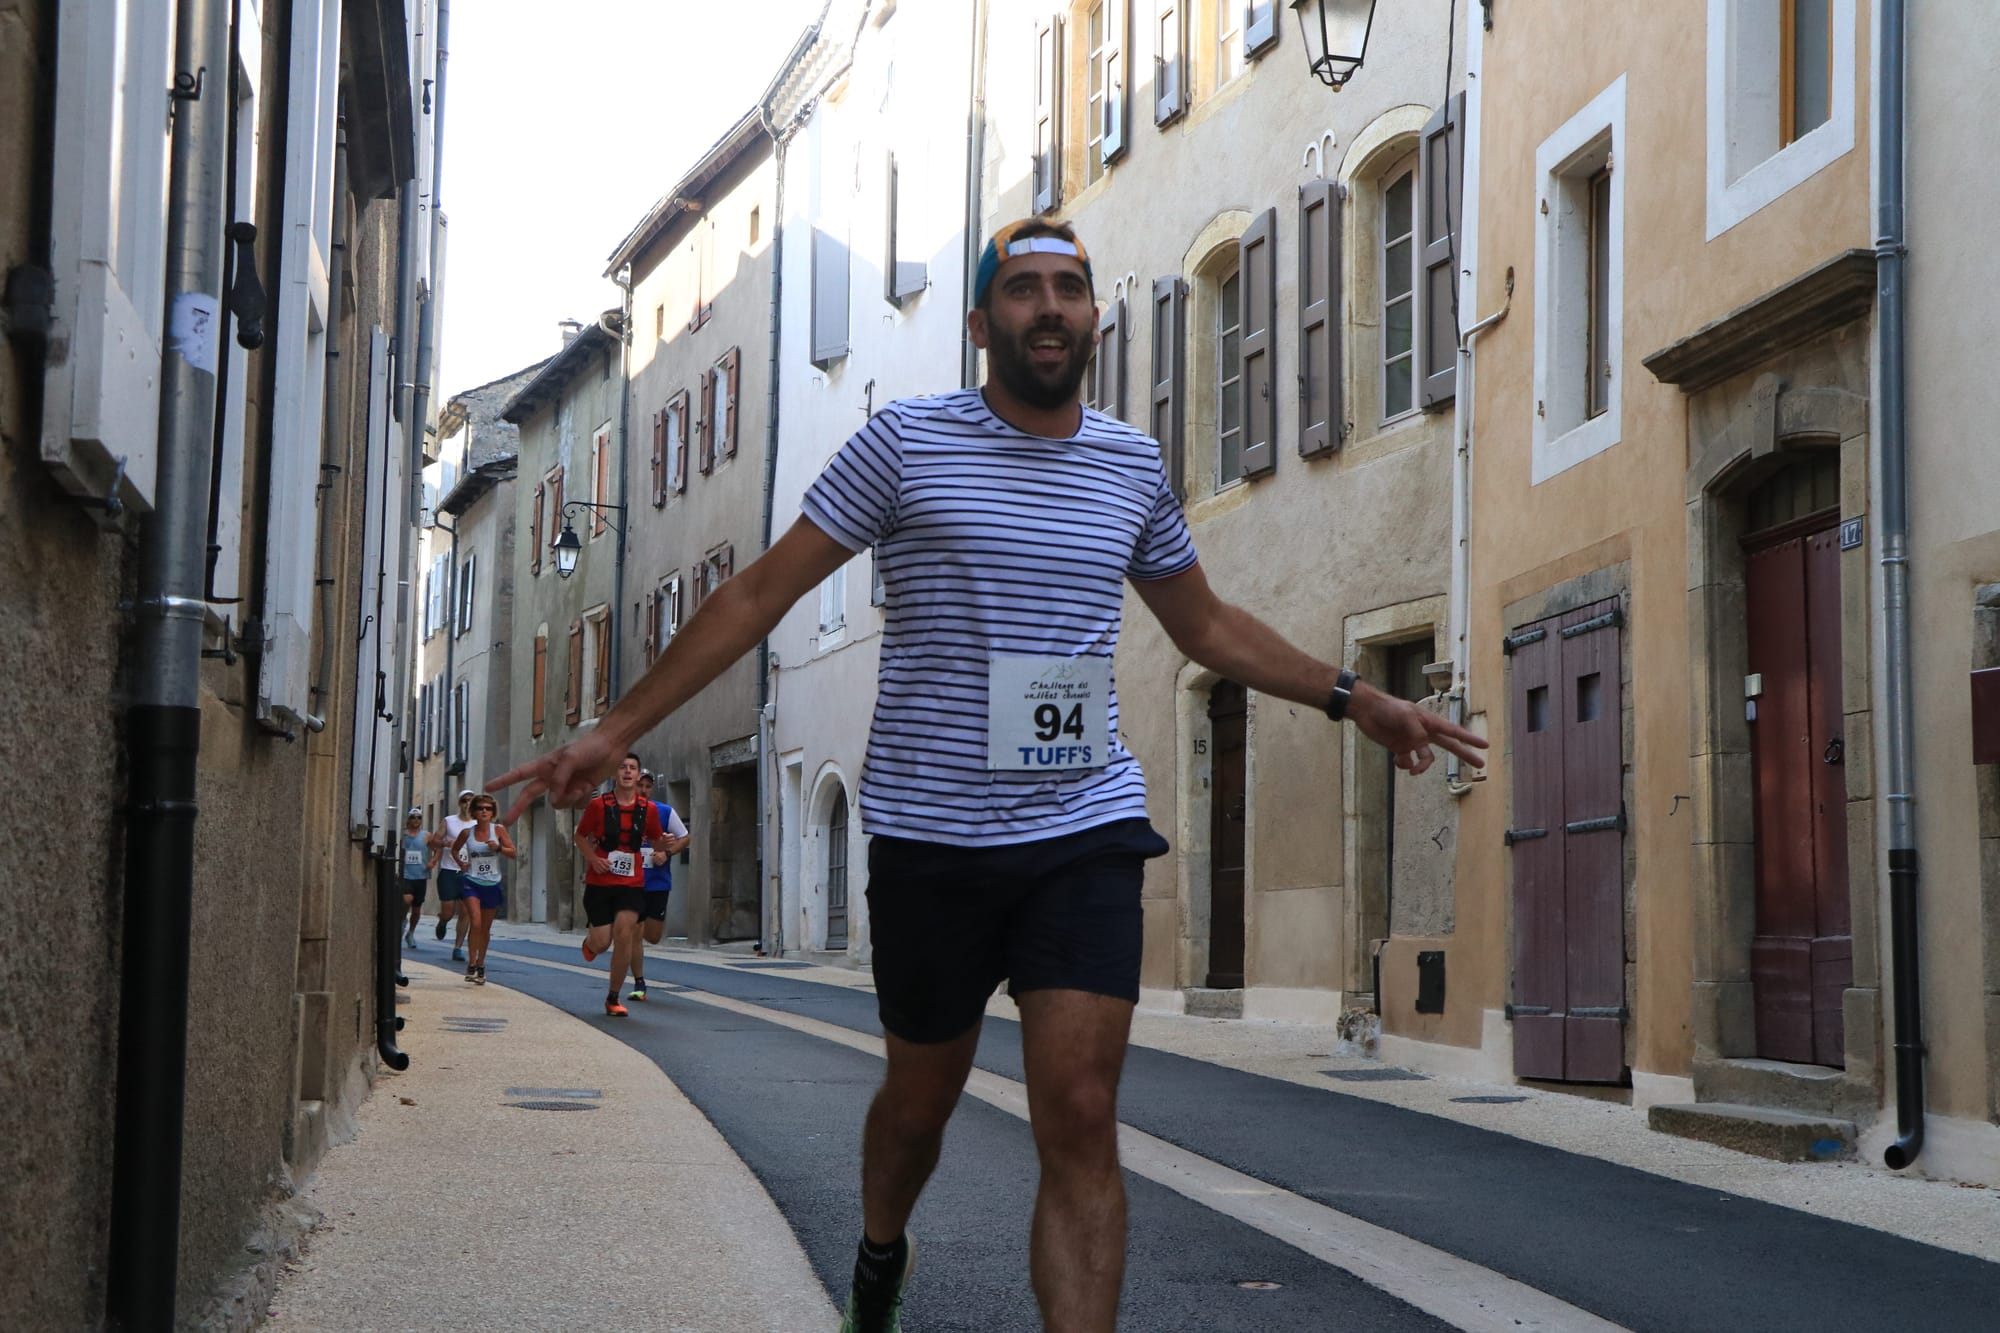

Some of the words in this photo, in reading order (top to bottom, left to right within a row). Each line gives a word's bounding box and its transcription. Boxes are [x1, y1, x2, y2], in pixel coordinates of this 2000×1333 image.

[1844, 522, 1858, 545] 17
[1030, 681, 1074, 693] Challenge
[1034, 703, 1084, 741] 94
[1193, 739, 1207, 754] 15
[1018, 745, 1092, 765] TUFF'S
[478, 864, 491, 872] 69
[613, 860, 632, 871] 153
